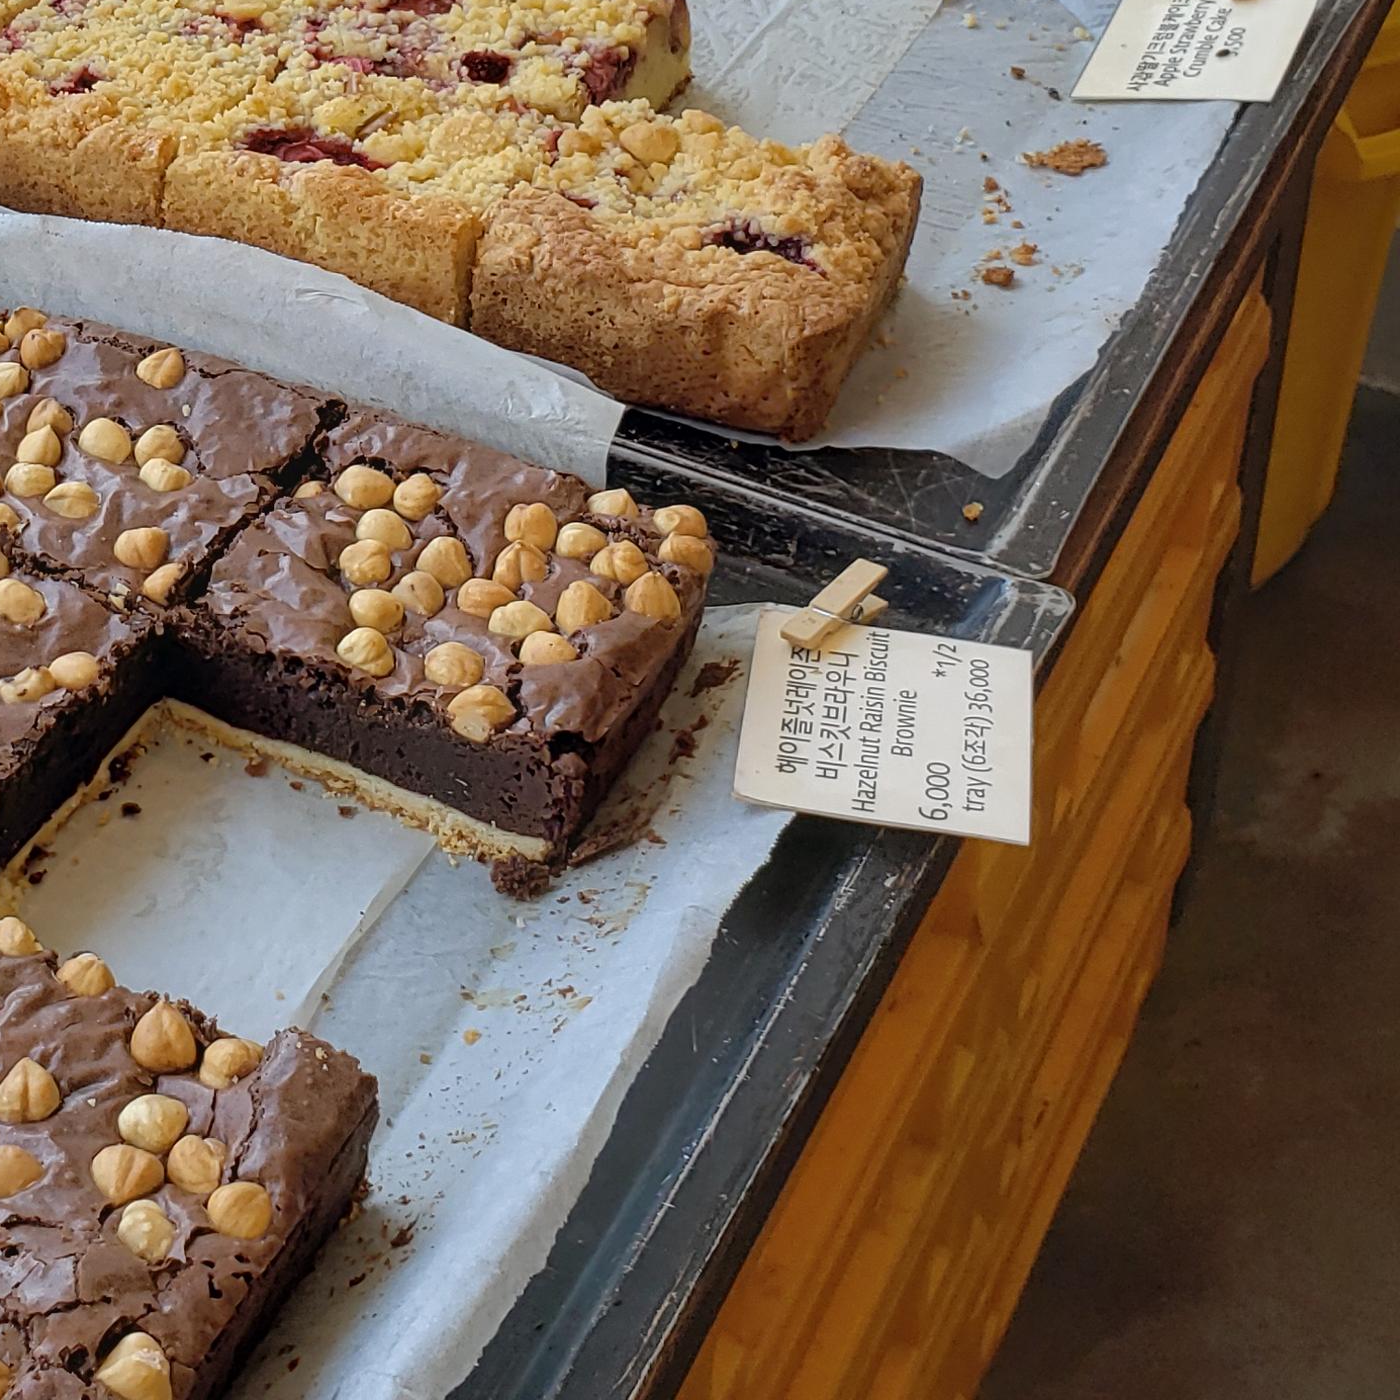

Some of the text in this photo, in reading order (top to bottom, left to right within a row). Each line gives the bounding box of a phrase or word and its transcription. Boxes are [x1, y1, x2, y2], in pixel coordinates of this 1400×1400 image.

[1153, 0, 1216, 87] Apple Strawberry
[1183, 8, 1232, 77] Crumble Cake
[775, 646, 821, 774] 헤이즐넛레이즌
[815, 652, 859, 779] 비스킷브라우니
[852, 631, 890, 812] Hazelnut Raisin Biscuit
[891, 690, 917, 757] Brownie
[961, 659, 994, 812] tray (6조각) 36,000
[919, 762, 952, 821] 6,000
